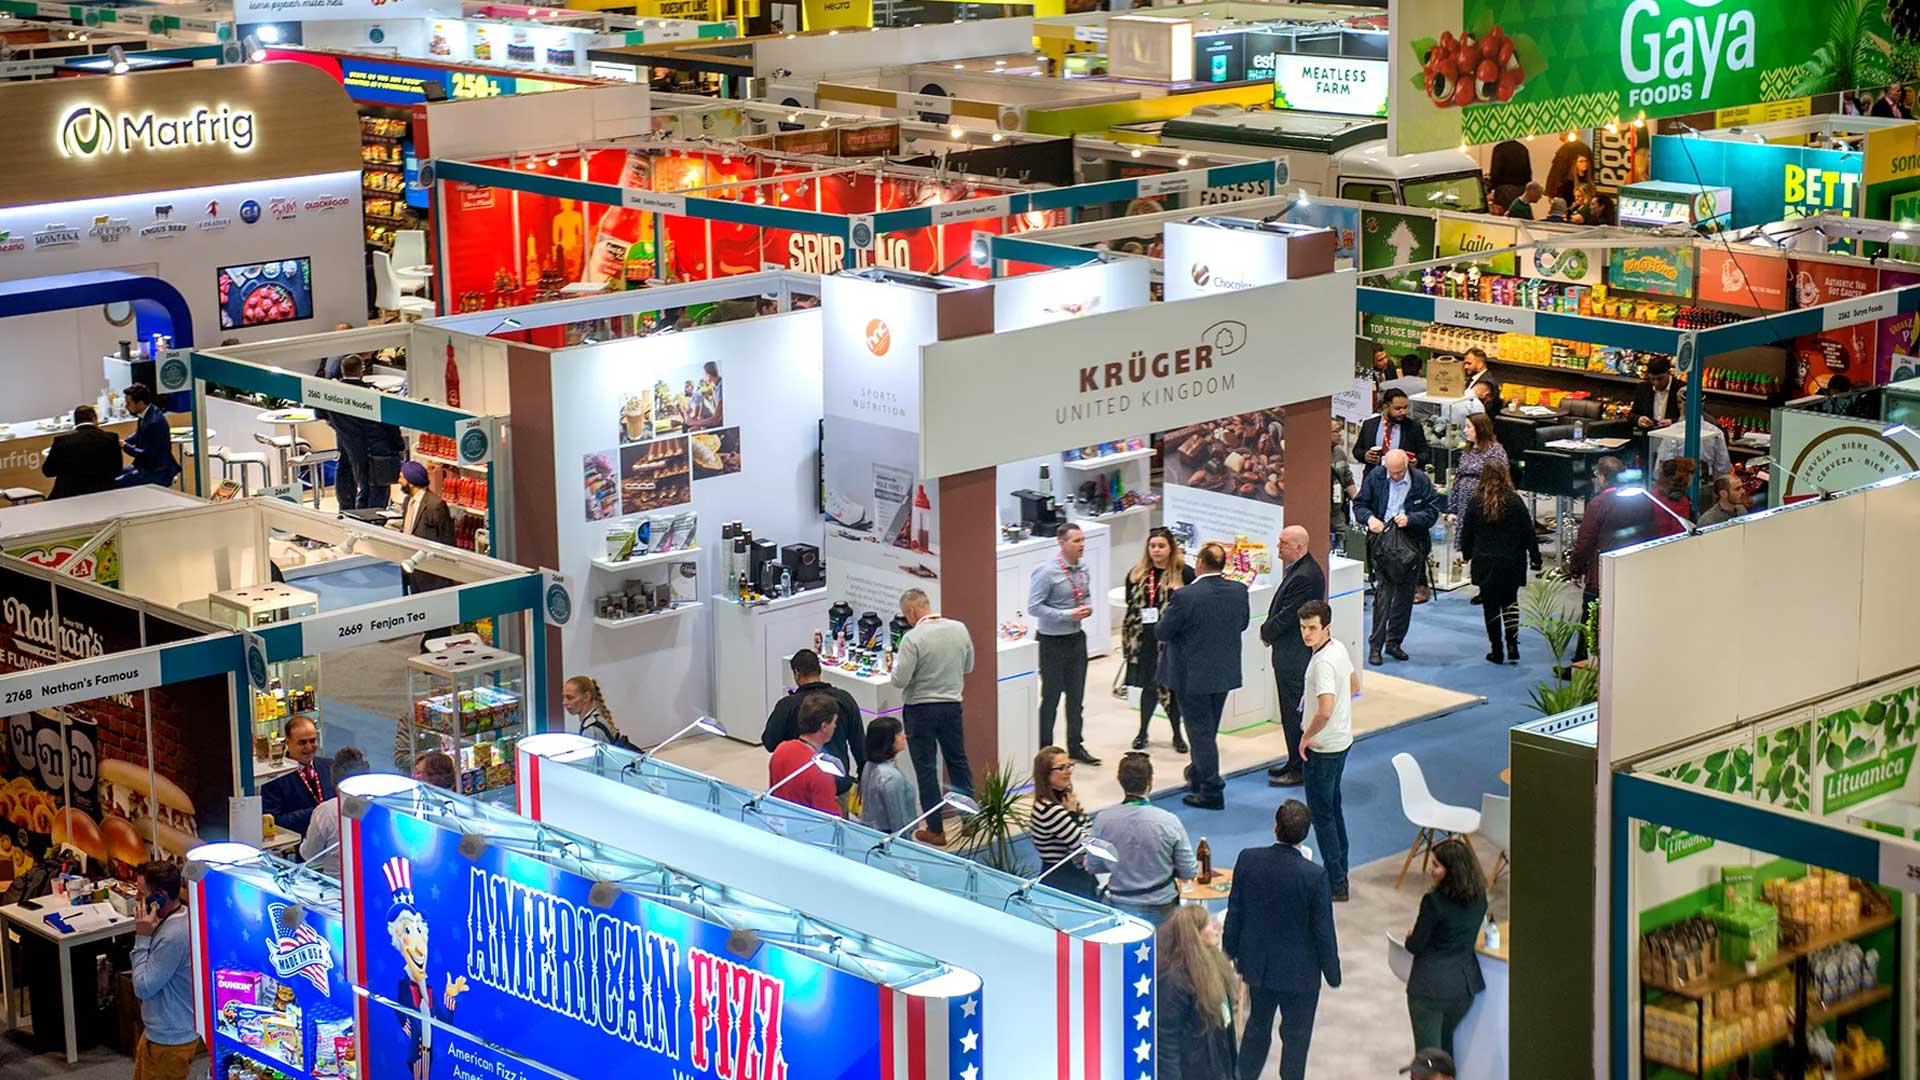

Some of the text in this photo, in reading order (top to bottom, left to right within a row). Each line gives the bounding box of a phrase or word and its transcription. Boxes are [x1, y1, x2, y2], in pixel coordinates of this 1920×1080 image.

[1620, 0, 1756, 100] Gaya
[452, 72, 501, 98] 250+
[1302, 67, 1366, 83] MEATLESS
[1316, 82, 1351, 95] FARM
[1628, 82, 1693, 107] FOODS
[123, 108, 253, 149] Marfrig
[35, 232, 80, 245] MONTANA
[1459, 233, 1494, 252] Laila
[1454, 310, 1514, 326] 2362 Surya Foods
[1868, 304, 1883, 314] Foods
[1370, 323, 1384, 334] TOP
[1390, 326, 1407, 338] RICE
[1079, 344, 1214, 394] KRÜGER
[307, 388, 322, 400] 2560
[344, 398, 352, 406] UK
[351, 398, 374, 411] Noodles
[860, 387, 898, 402] SPORTS
[1055, 373, 1236, 425] UNITED KINGDOM
[852, 399, 906, 417] NUTRITION
[1816, 456, 1886, 483] CERVEZA BIER
[338, 612, 426, 637] 2669 Fenjan Tea
[5, 669, 140, 704] 2768 Nathan's Famous
[1826, 756, 1905, 800] Lituanica
[278, 947, 324, 971] MADE IN USA
[467, 866, 789, 1080] AMERICAN FIZZ
[218, 980, 253, 992] DUNKIN'
[447, 1042, 495, 1073] American
[496, 1062, 518, 1080] Fizz
